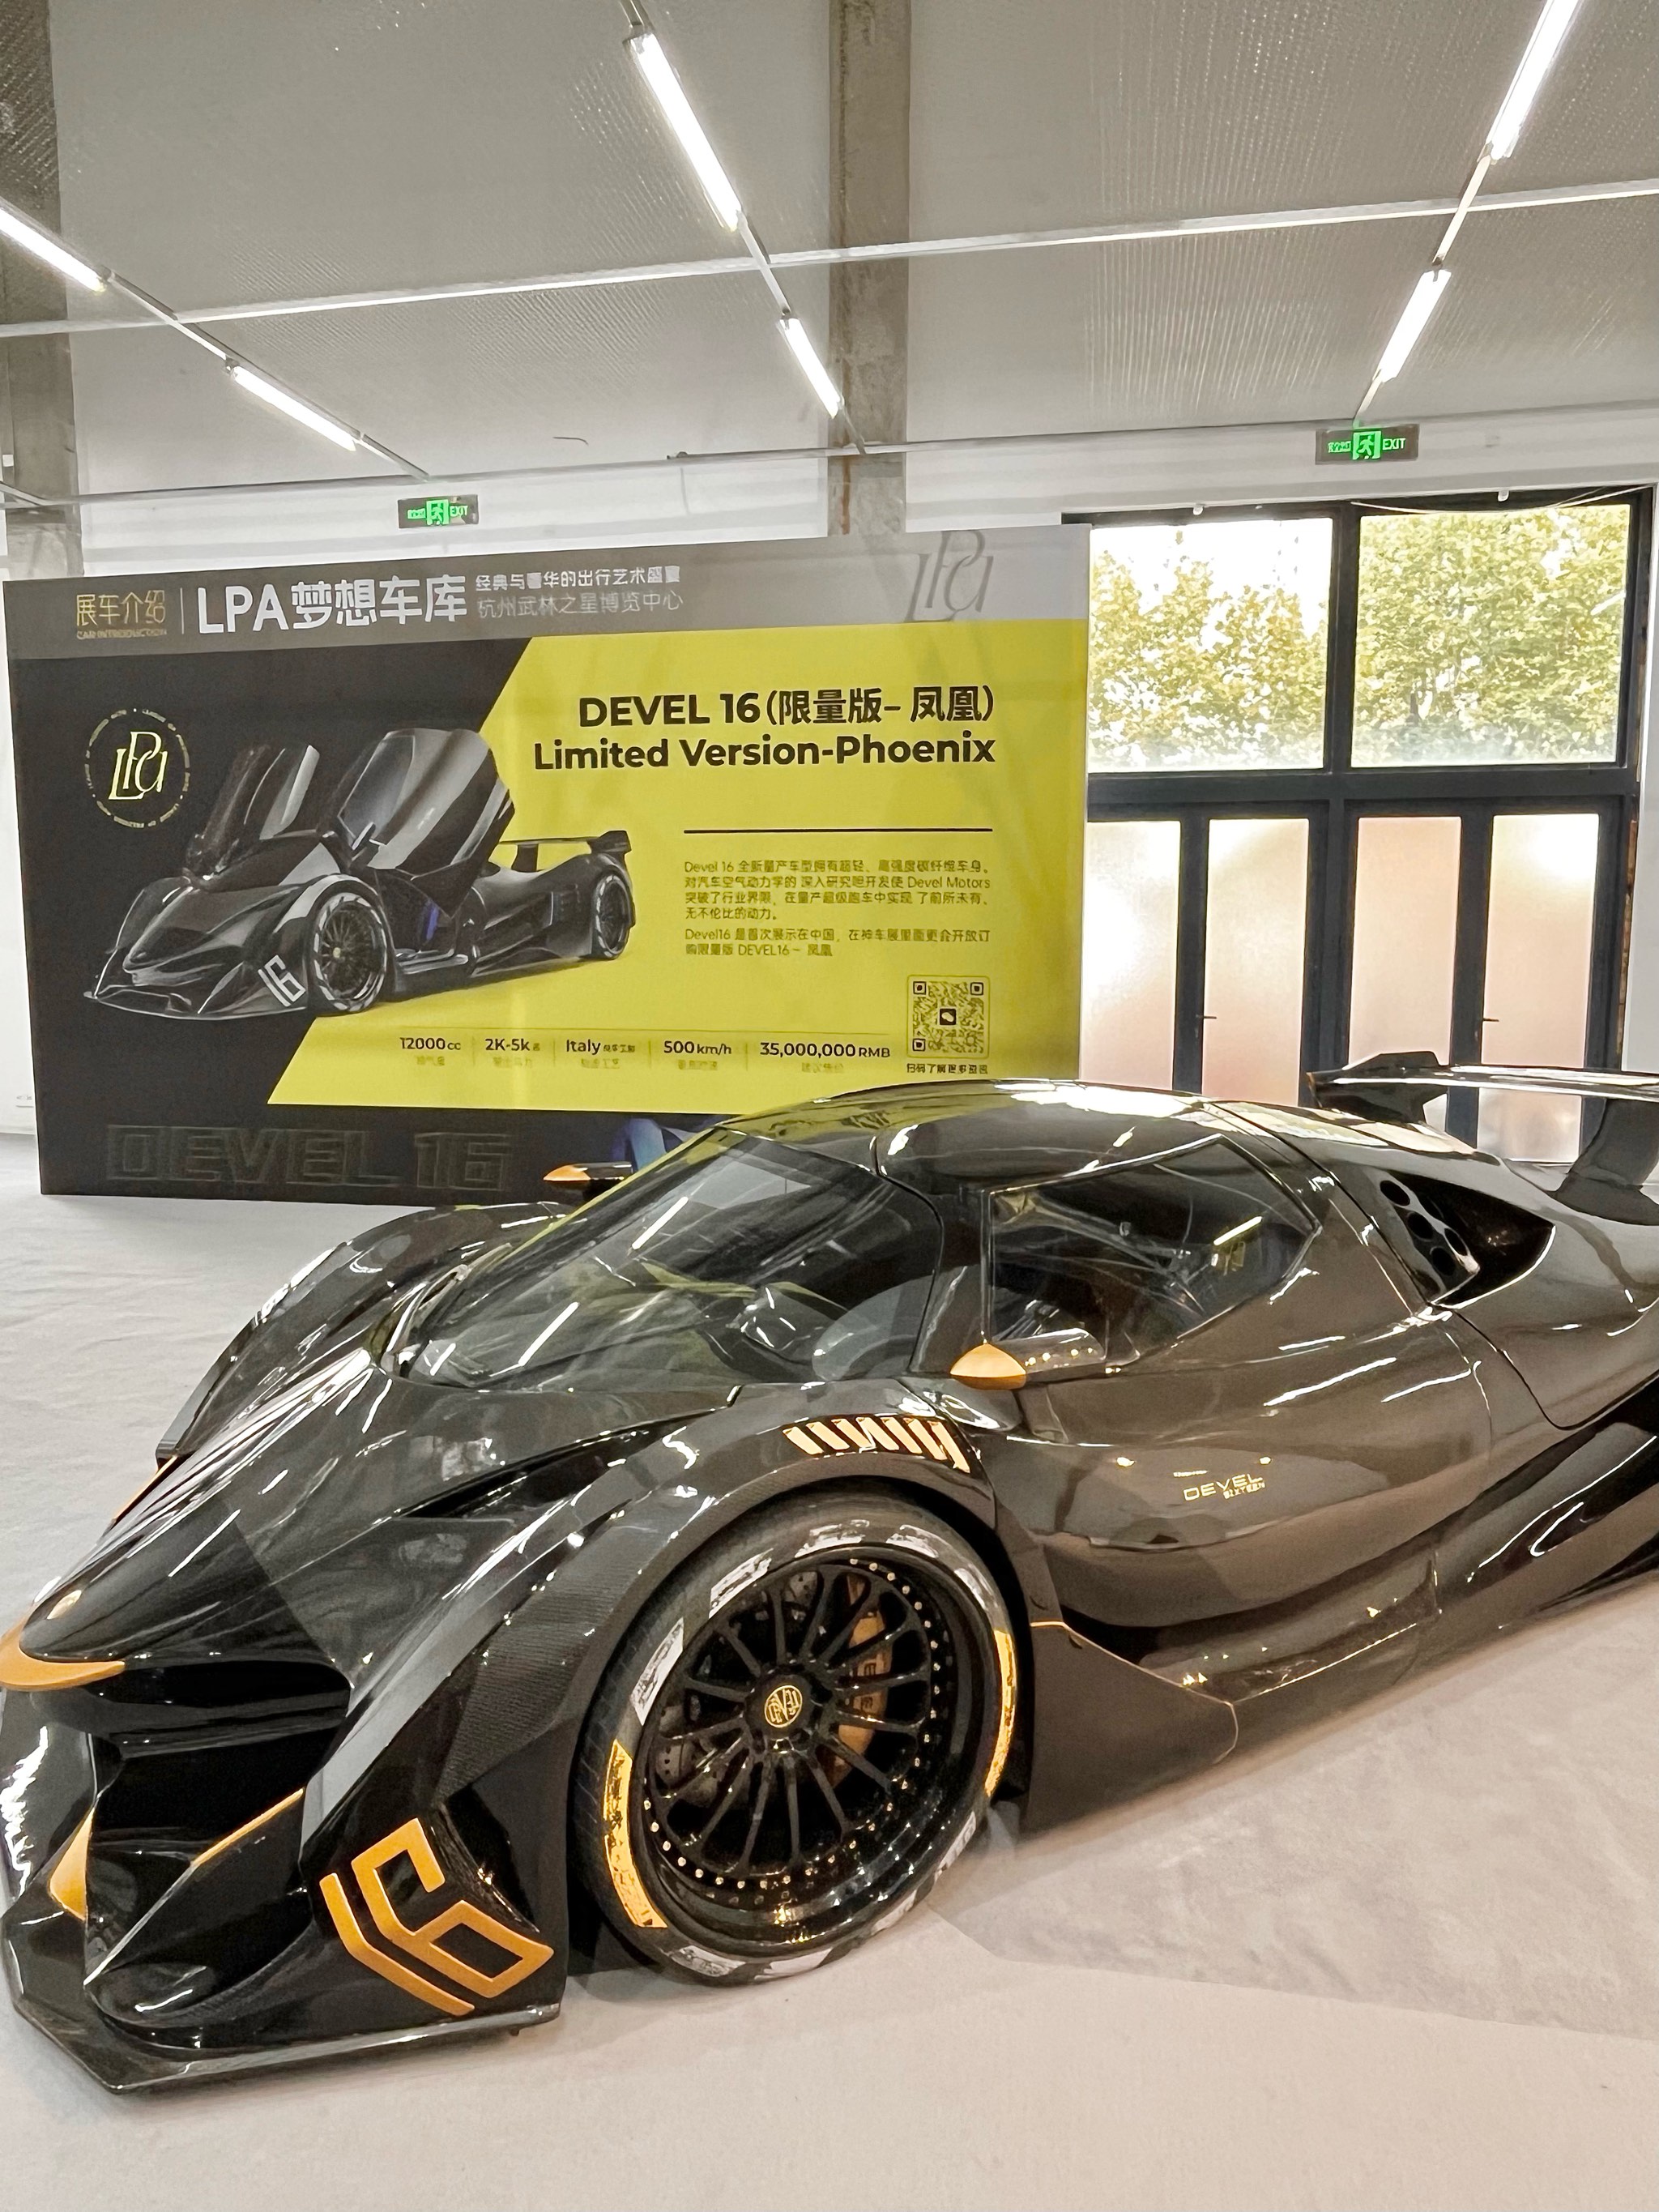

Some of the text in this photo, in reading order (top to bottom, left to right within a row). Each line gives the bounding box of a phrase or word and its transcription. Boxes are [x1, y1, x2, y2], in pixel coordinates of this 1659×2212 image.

[1382, 438, 1405, 451] EXIT
[450, 505, 468, 517] EXIT
[476, 566, 680, 592] 经典与华的出行艺术盛
[76, 589, 166, 627] 展车介绍
[477, 589, 684, 619] 杭州武林之星博览中心
[579, 694, 710, 727] DEVEL
[534, 730, 996, 769] Limited Version-Phoenix
[684, 861, 718, 873] Devel
[722, 861, 734, 873] 16
[907, 876, 943, 888] Devel
[946, 876, 990, 889] Motors
[684, 929, 731, 941] Devel16
[258, 954, 306, 1007] 16
[566, 1039, 601, 1055] Italy
[105, 1124, 510, 1190] DEVEL 16
[1183, 1473, 1263, 1501] DEVEL
[319, 1817, 554, 2016] 16
